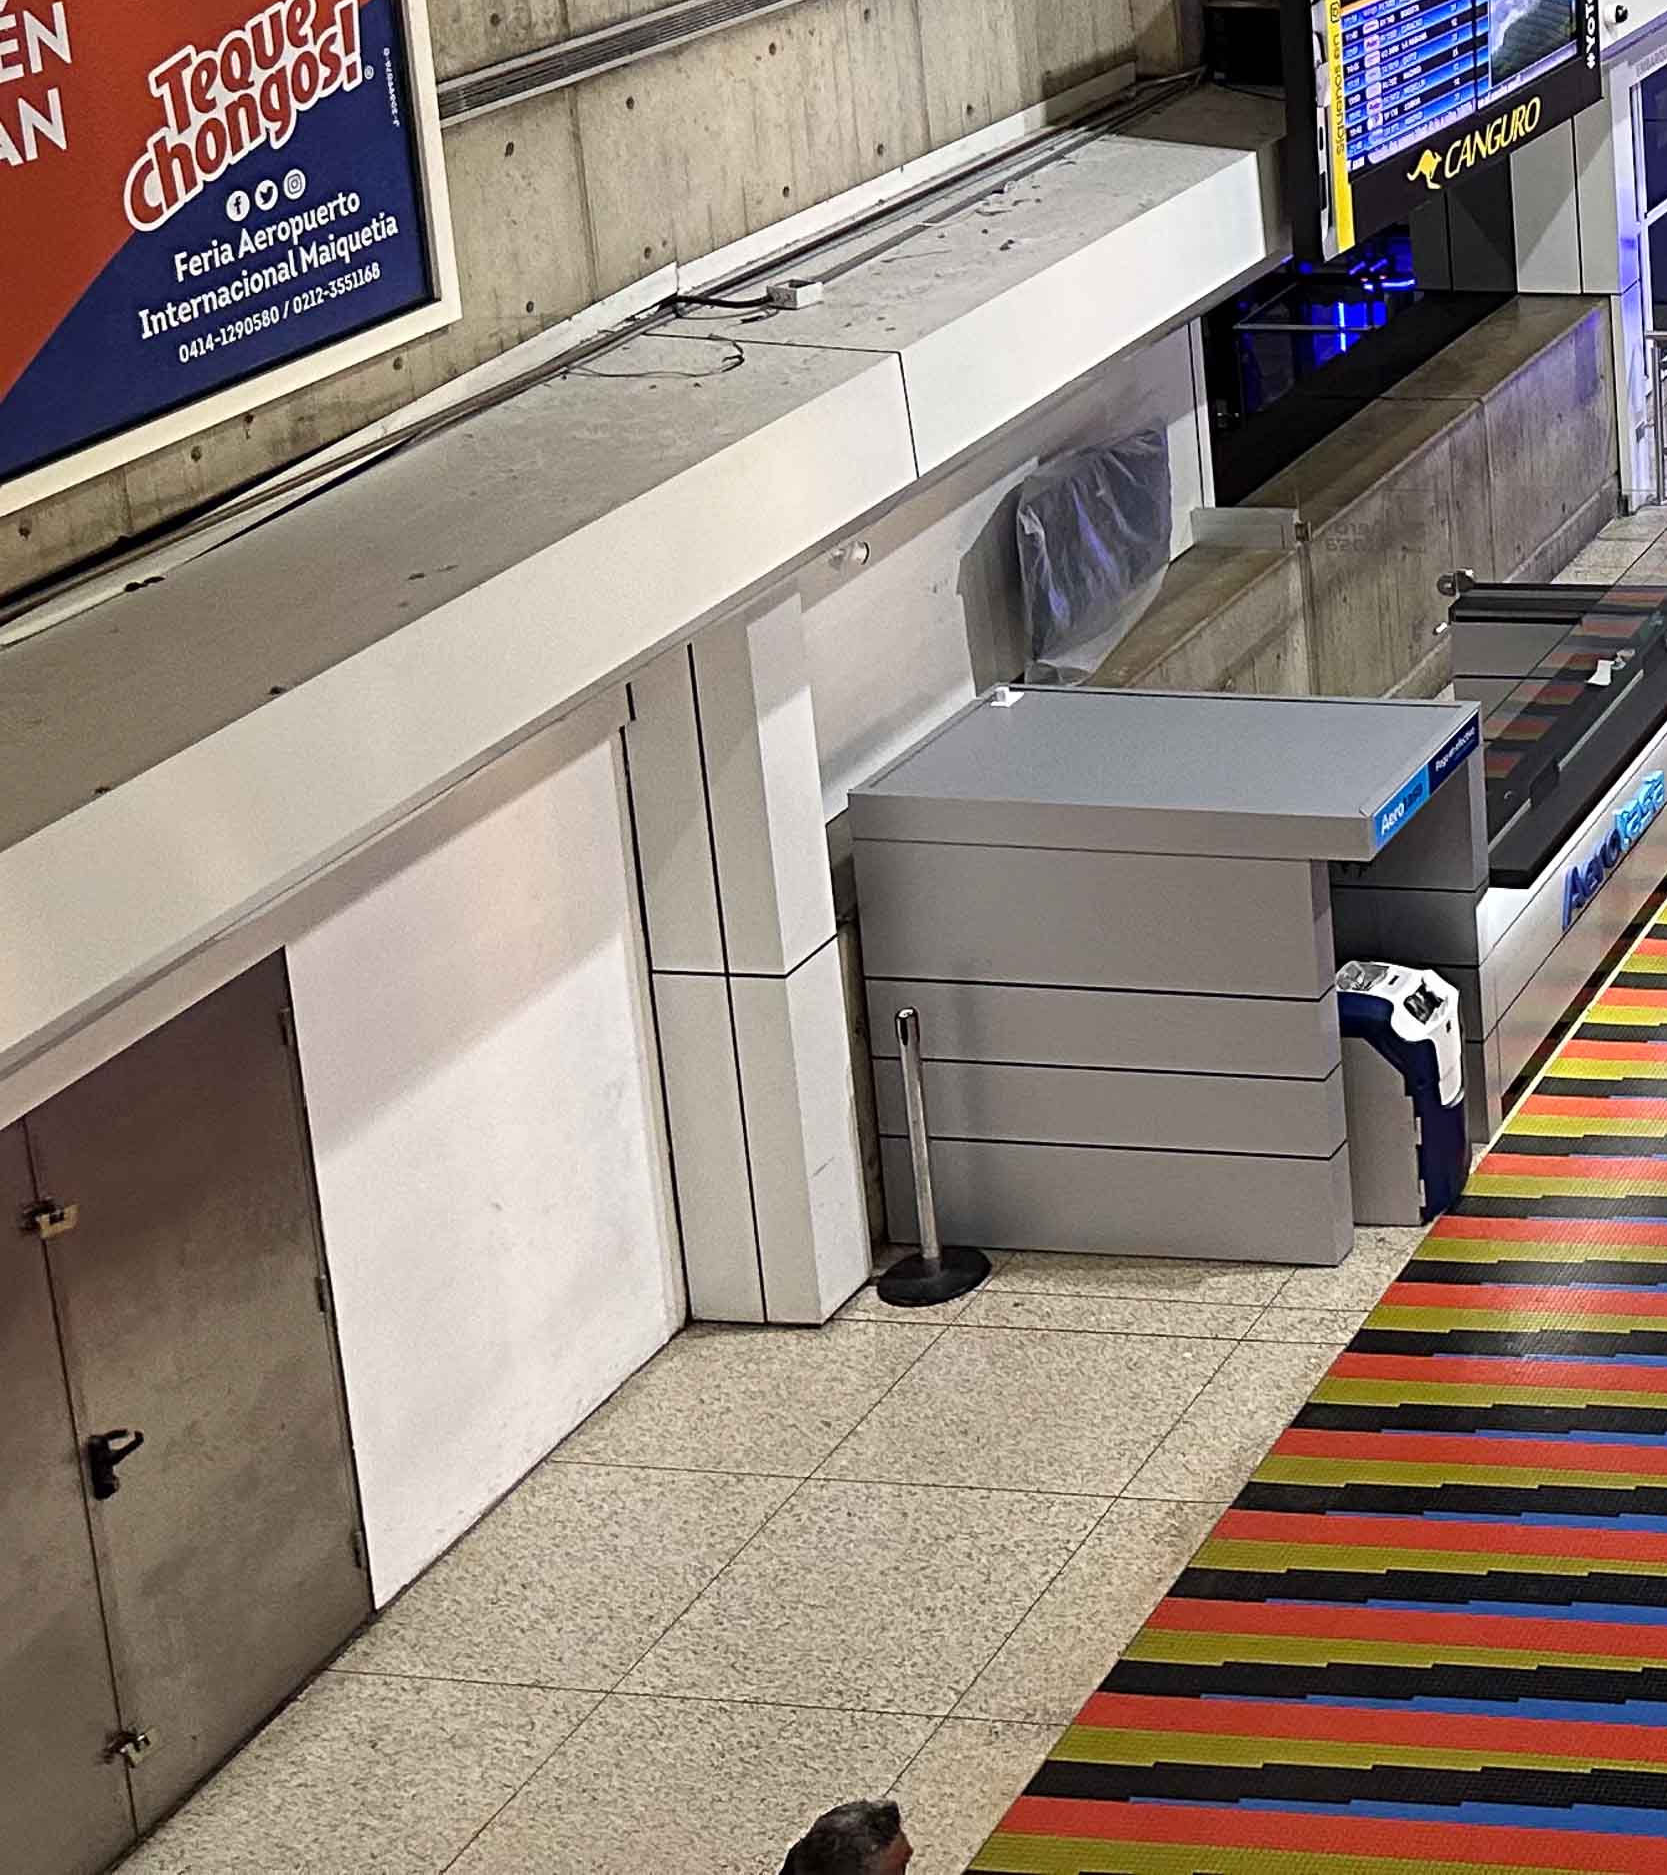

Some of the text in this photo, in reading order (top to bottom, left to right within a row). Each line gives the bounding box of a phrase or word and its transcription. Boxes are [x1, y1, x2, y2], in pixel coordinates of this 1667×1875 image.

[1444, 97, 1541, 178] CANGURO
[138, 212, 399, 339] Internacional Maiquetía
[174, 191, 361, 282] Feria Aeropuerto
[179, 262, 381, 363] 0414-1290580 / 0212-3551168
